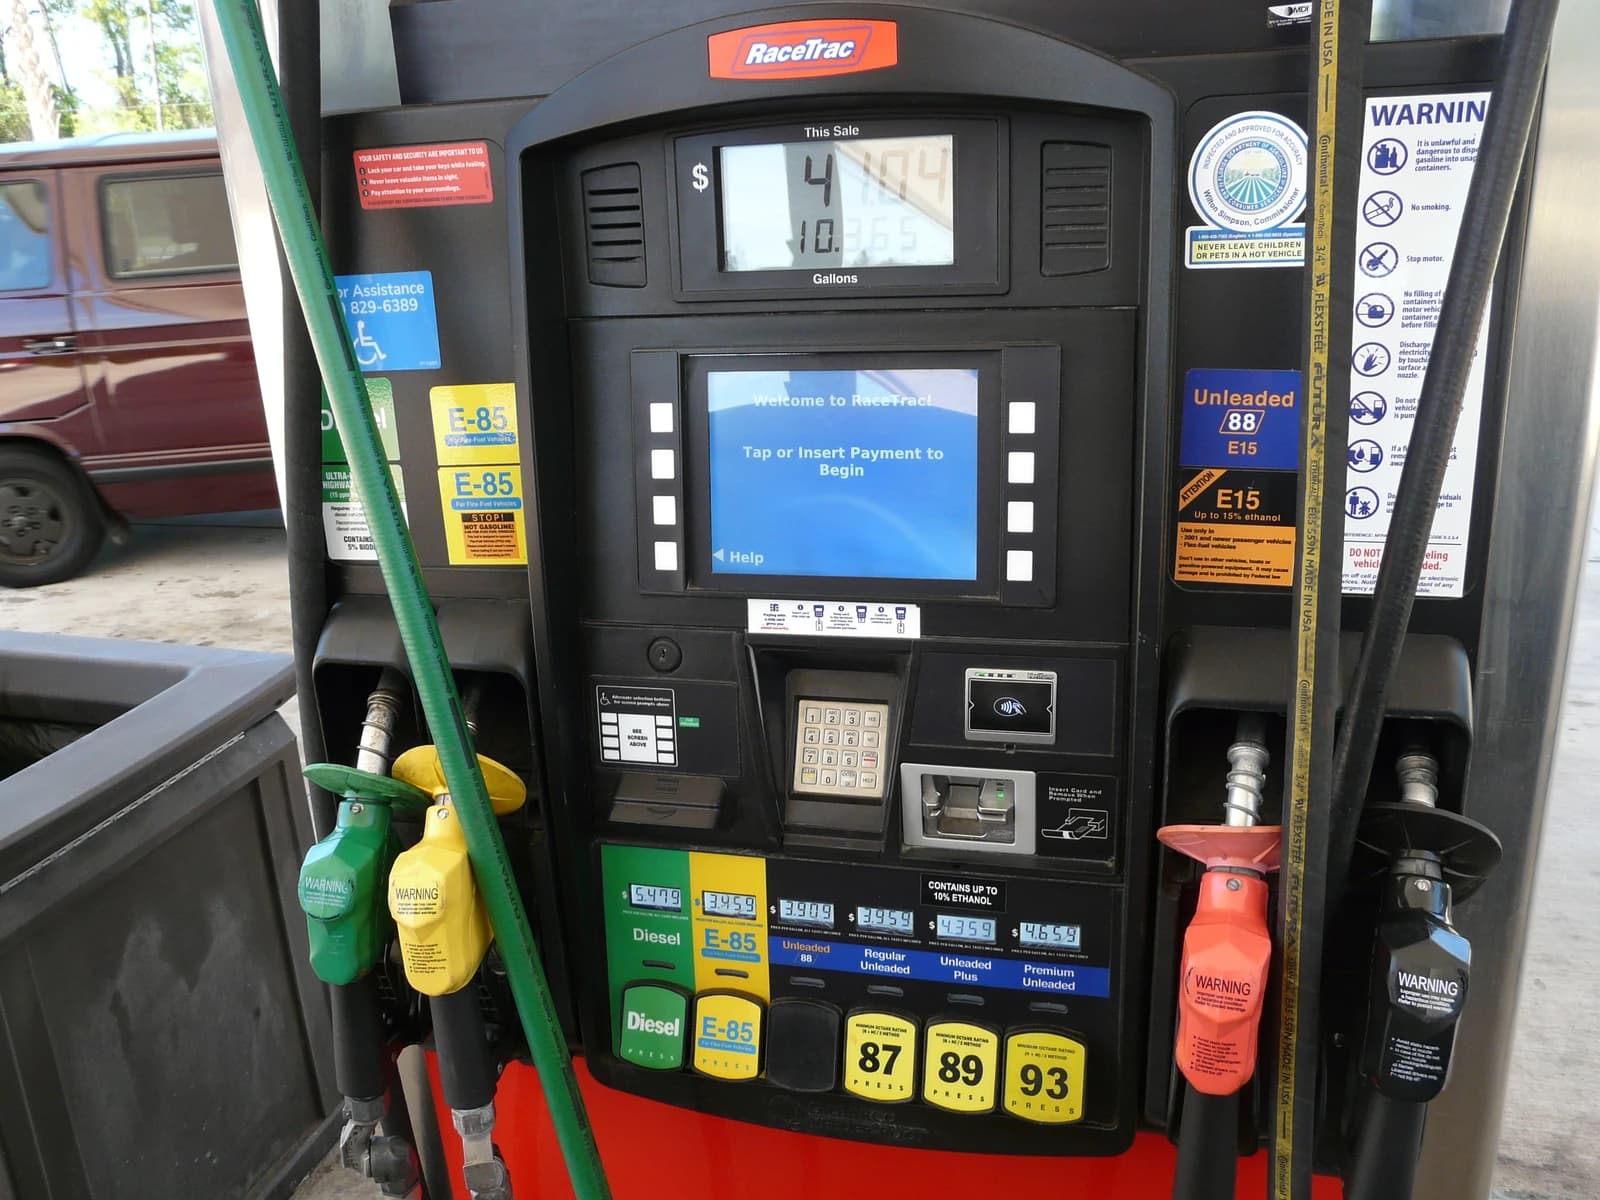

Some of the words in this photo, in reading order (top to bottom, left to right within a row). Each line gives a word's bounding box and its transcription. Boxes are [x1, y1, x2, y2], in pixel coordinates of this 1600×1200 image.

[745, 38, 856, 66] RaceTrac
[1371, 100, 1486, 127] WARNIN
[804, 127, 830, 138] This
[833, 126, 860, 137] Sale
[1203, 138, 1225, 170] INSPECTED
[1224, 130, 1237, 141] AND
[1238, 125, 1271, 134] APPROVED
[1272, 127, 1284, 138] FOR
[1424, 139, 1429, 147] is
[1431, 138, 1461, 146] unlawful
[374, 153, 392, 161] SAFETY
[392, 152, 402, 160] AND
[403, 151, 428, 160] SECURITY
[428, 150, 438, 158] ARE
[439, 148, 468, 157] IMPORTANT
[1416, 148, 1452, 156] dangerous
[1319, 135, 1331, 189] Continental
[1414, 164, 1452, 172] containers.
[1415, 156, 1444, 166] gasoline
[692, 162, 709, 193] $
[1203, 189, 1219, 213] Wilton
[1218, 209, 1252, 227] Simpson,
[1254, 187, 1300, 226] Commissioner
[1421, 203, 1452, 213] smoking.
[1197, 243, 1226, 251] NEVER
[1228, 242, 1255, 250] LEAVE
[1258, 241, 1301, 249] CHILDREN
[1196, 252, 1208, 260] OR
[1209, 252, 1230, 260] PETS
[1249, 250, 1265, 258] HOT
[1267, 250, 1302, 258] VEHICLE
[1406, 255, 1422, 264] Stop
[1423, 255, 1445, 263] motor.
[812, 273, 858, 285] Gallons
[353, 283, 424, 297] Assistance
[1414, 290, 1433, 298] filling
[351, 298, 418, 314] 829-6389
[1314, 293, 1324, 353] FLEXSTEEL
[1400, 341, 1431, 350] Discharge
[753, 395, 825, 408] Welcome
[828, 395, 846, 408] to
[852, 394, 932, 408] RaceTrac!
[1194, 389, 1294, 408] Unleaded
[1311, 362, 1323, 449] FUTURA
[448, 406, 508, 432] E-85
[1228, 413, 1256, 431] 88
[743, 446, 772, 462] Tap
[776, 448, 794, 460] or
[798, 446, 844, 460] Insert
[850, 446, 922, 464] Payment
[926, 448, 944, 460] to
[1228, 441, 1258, 455] E15
[820, 463, 864, 480] Begin
[454, 472, 514, 496] E-85
[1181, 470, 1215, 502] ATTENTION
[1216, 488, 1260, 510] E15
[471, 513, 505, 522] STOP!
[1194, 511, 1207, 521] Up
[1209, 512, 1220, 520] to
[1222, 512, 1242, 521] 15%
[1244, 512, 1281, 522] ethanol
[730, 550, 764, 567] Help
[1349, 548, 1362, 558] DO
[1364, 548, 1382, 558] NOT
[1354, 559, 1380, 569] vehicl
[1304, 559, 1314, 591] MADE
[1304, 595, 1312, 607] IN
[1302, 610, 1312, 632] USA
[395, 888, 439, 900] WARNING
[635, 886, 680, 905] 5.479
[928, 880, 971, 893] CONTAINS
[972, 884, 984, 894] UP
[985, 886, 998, 896] TO
[934, 892, 950, 902] 10%
[952, 893, 992, 906] ETHANOL
[633, 928, 680, 946] Diesel
[704, 928, 757, 952] E-85
[782, 940, 830, 953] Unleaded
[800, 953, 812, 963] 88
[864, 948, 906, 962] Regular
[860, 960, 910, 975] Unleaded
[940, 956, 992, 971] Unleaded
[1024, 963, 1075, 978] Premium
[954, 970, 978, 982] Plus
[1398, 971, 1458, 996] WARNING
[1022, 977, 1076, 992] Unleaded
[1196, 974, 1251, 996] WARNING
[627, 1010, 680, 1037] Diesel
[702, 1016, 753, 1042] E-85
[858, 1042, 902, 1076] 87
[938, 1052, 984, 1086] 89
[1020, 1064, 1069, 1100] 93
